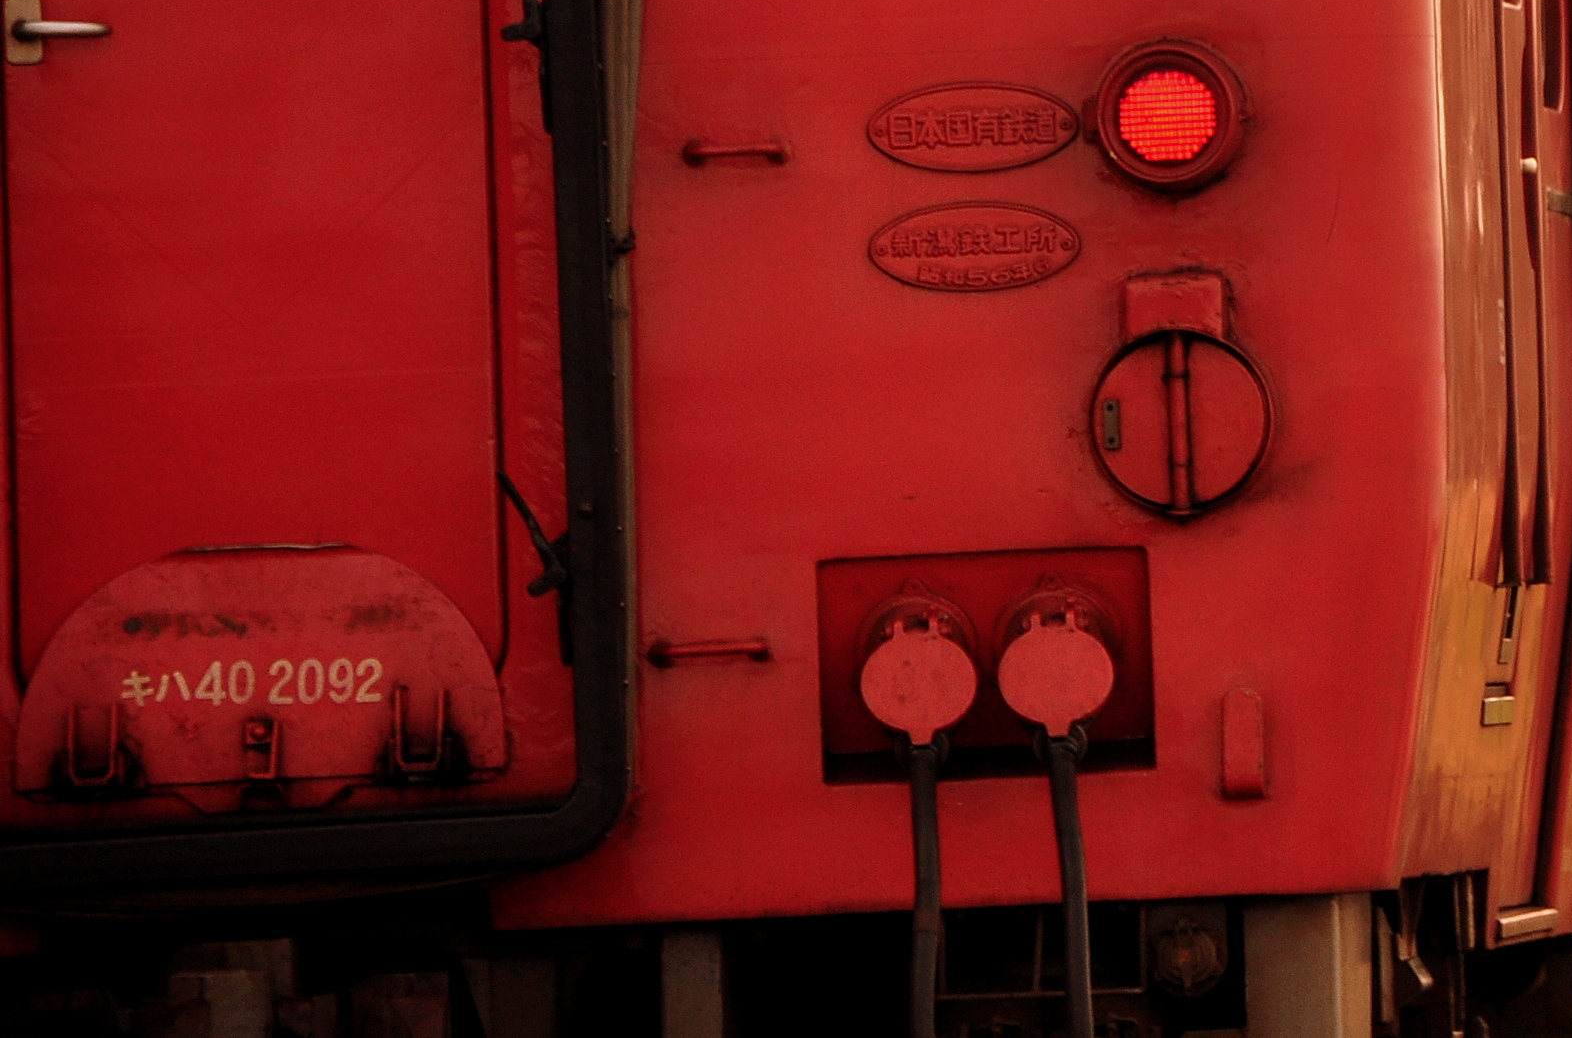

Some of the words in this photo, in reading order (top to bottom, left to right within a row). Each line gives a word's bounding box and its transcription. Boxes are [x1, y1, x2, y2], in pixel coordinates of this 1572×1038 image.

[887, 109, 1057, 149] 日本国有鉄道
[268, 658, 383, 705] 2092
